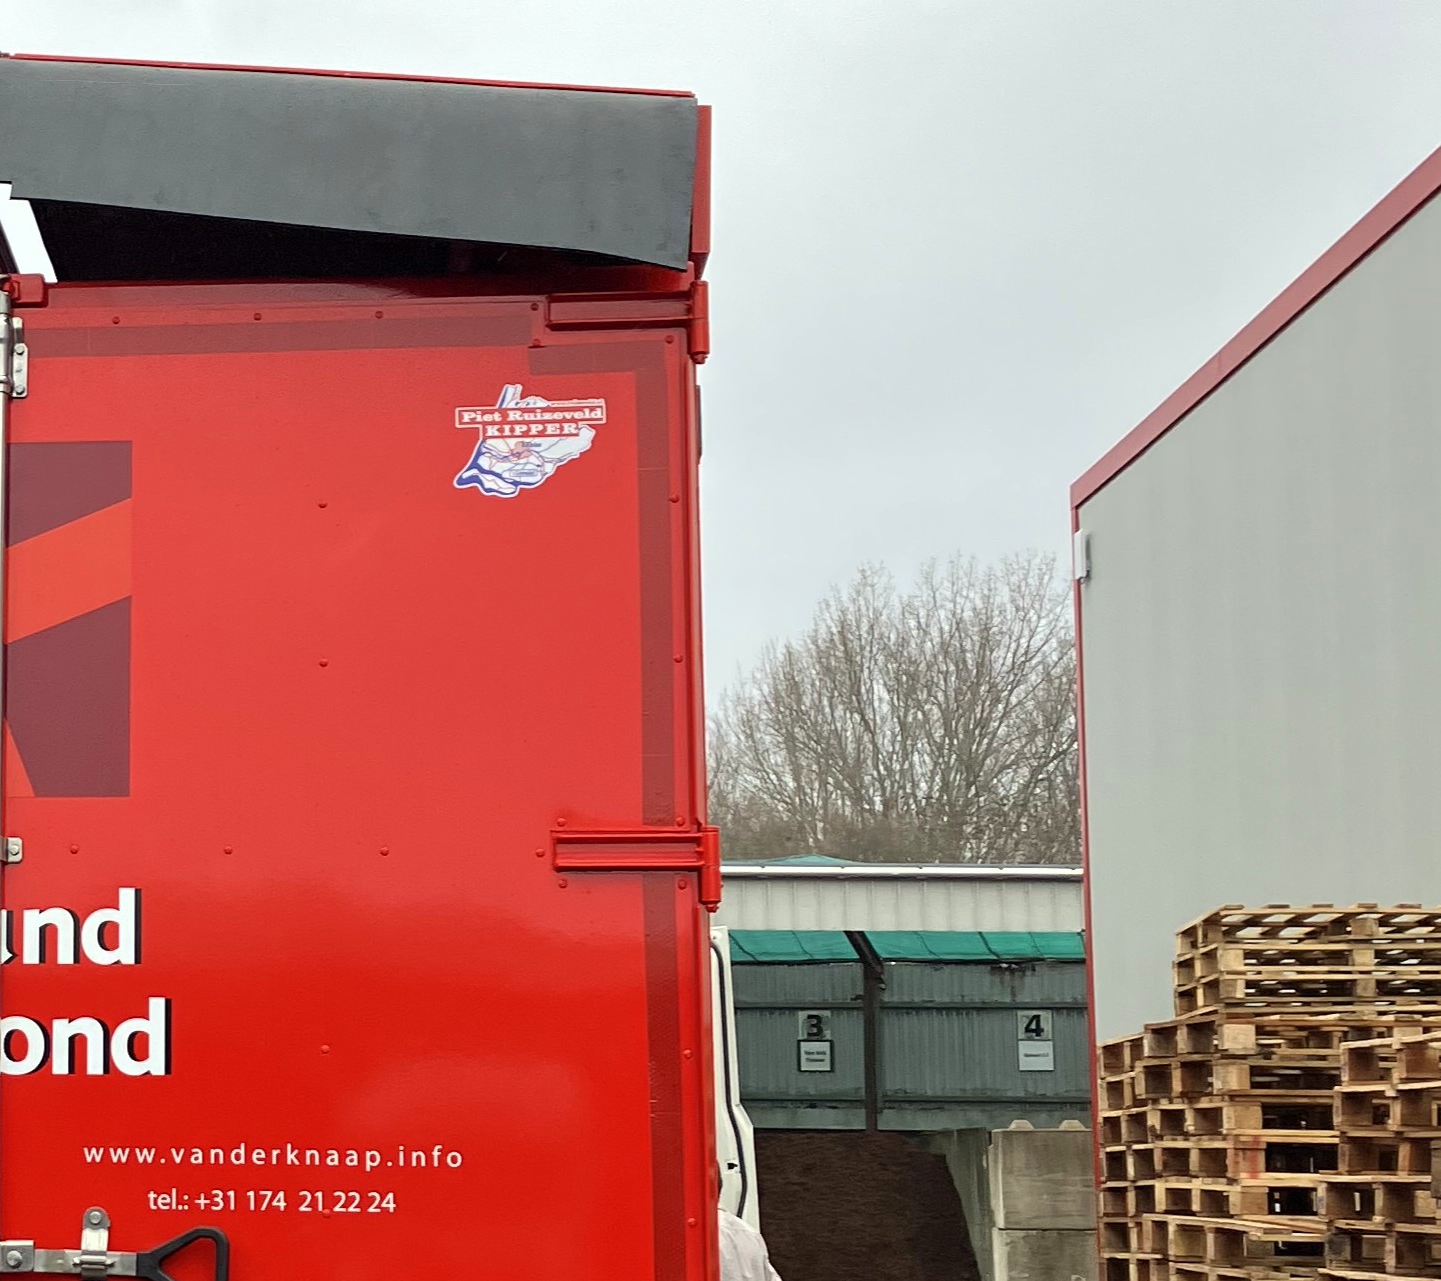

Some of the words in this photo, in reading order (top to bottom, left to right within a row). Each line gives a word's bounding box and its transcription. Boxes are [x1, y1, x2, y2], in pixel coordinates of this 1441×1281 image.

[461, 411, 502, 422] Piet
[507, 408, 603, 421] Ruizeveld
[485, 422, 579, 436] KIPPER
[807, 1015, 823, 1036] 3
[1025, 1014, 1044, 1037] 4
[83, 1142, 464, 1172] www.vanderknaap.info
[194, 1189, 236, 1211] +31
[246, 1190, 287, 1211] 174
[298, 1191, 324, 1212] 21
[333, 1191, 361, 1213] 22
[366, 1191, 397, 1213] 24
